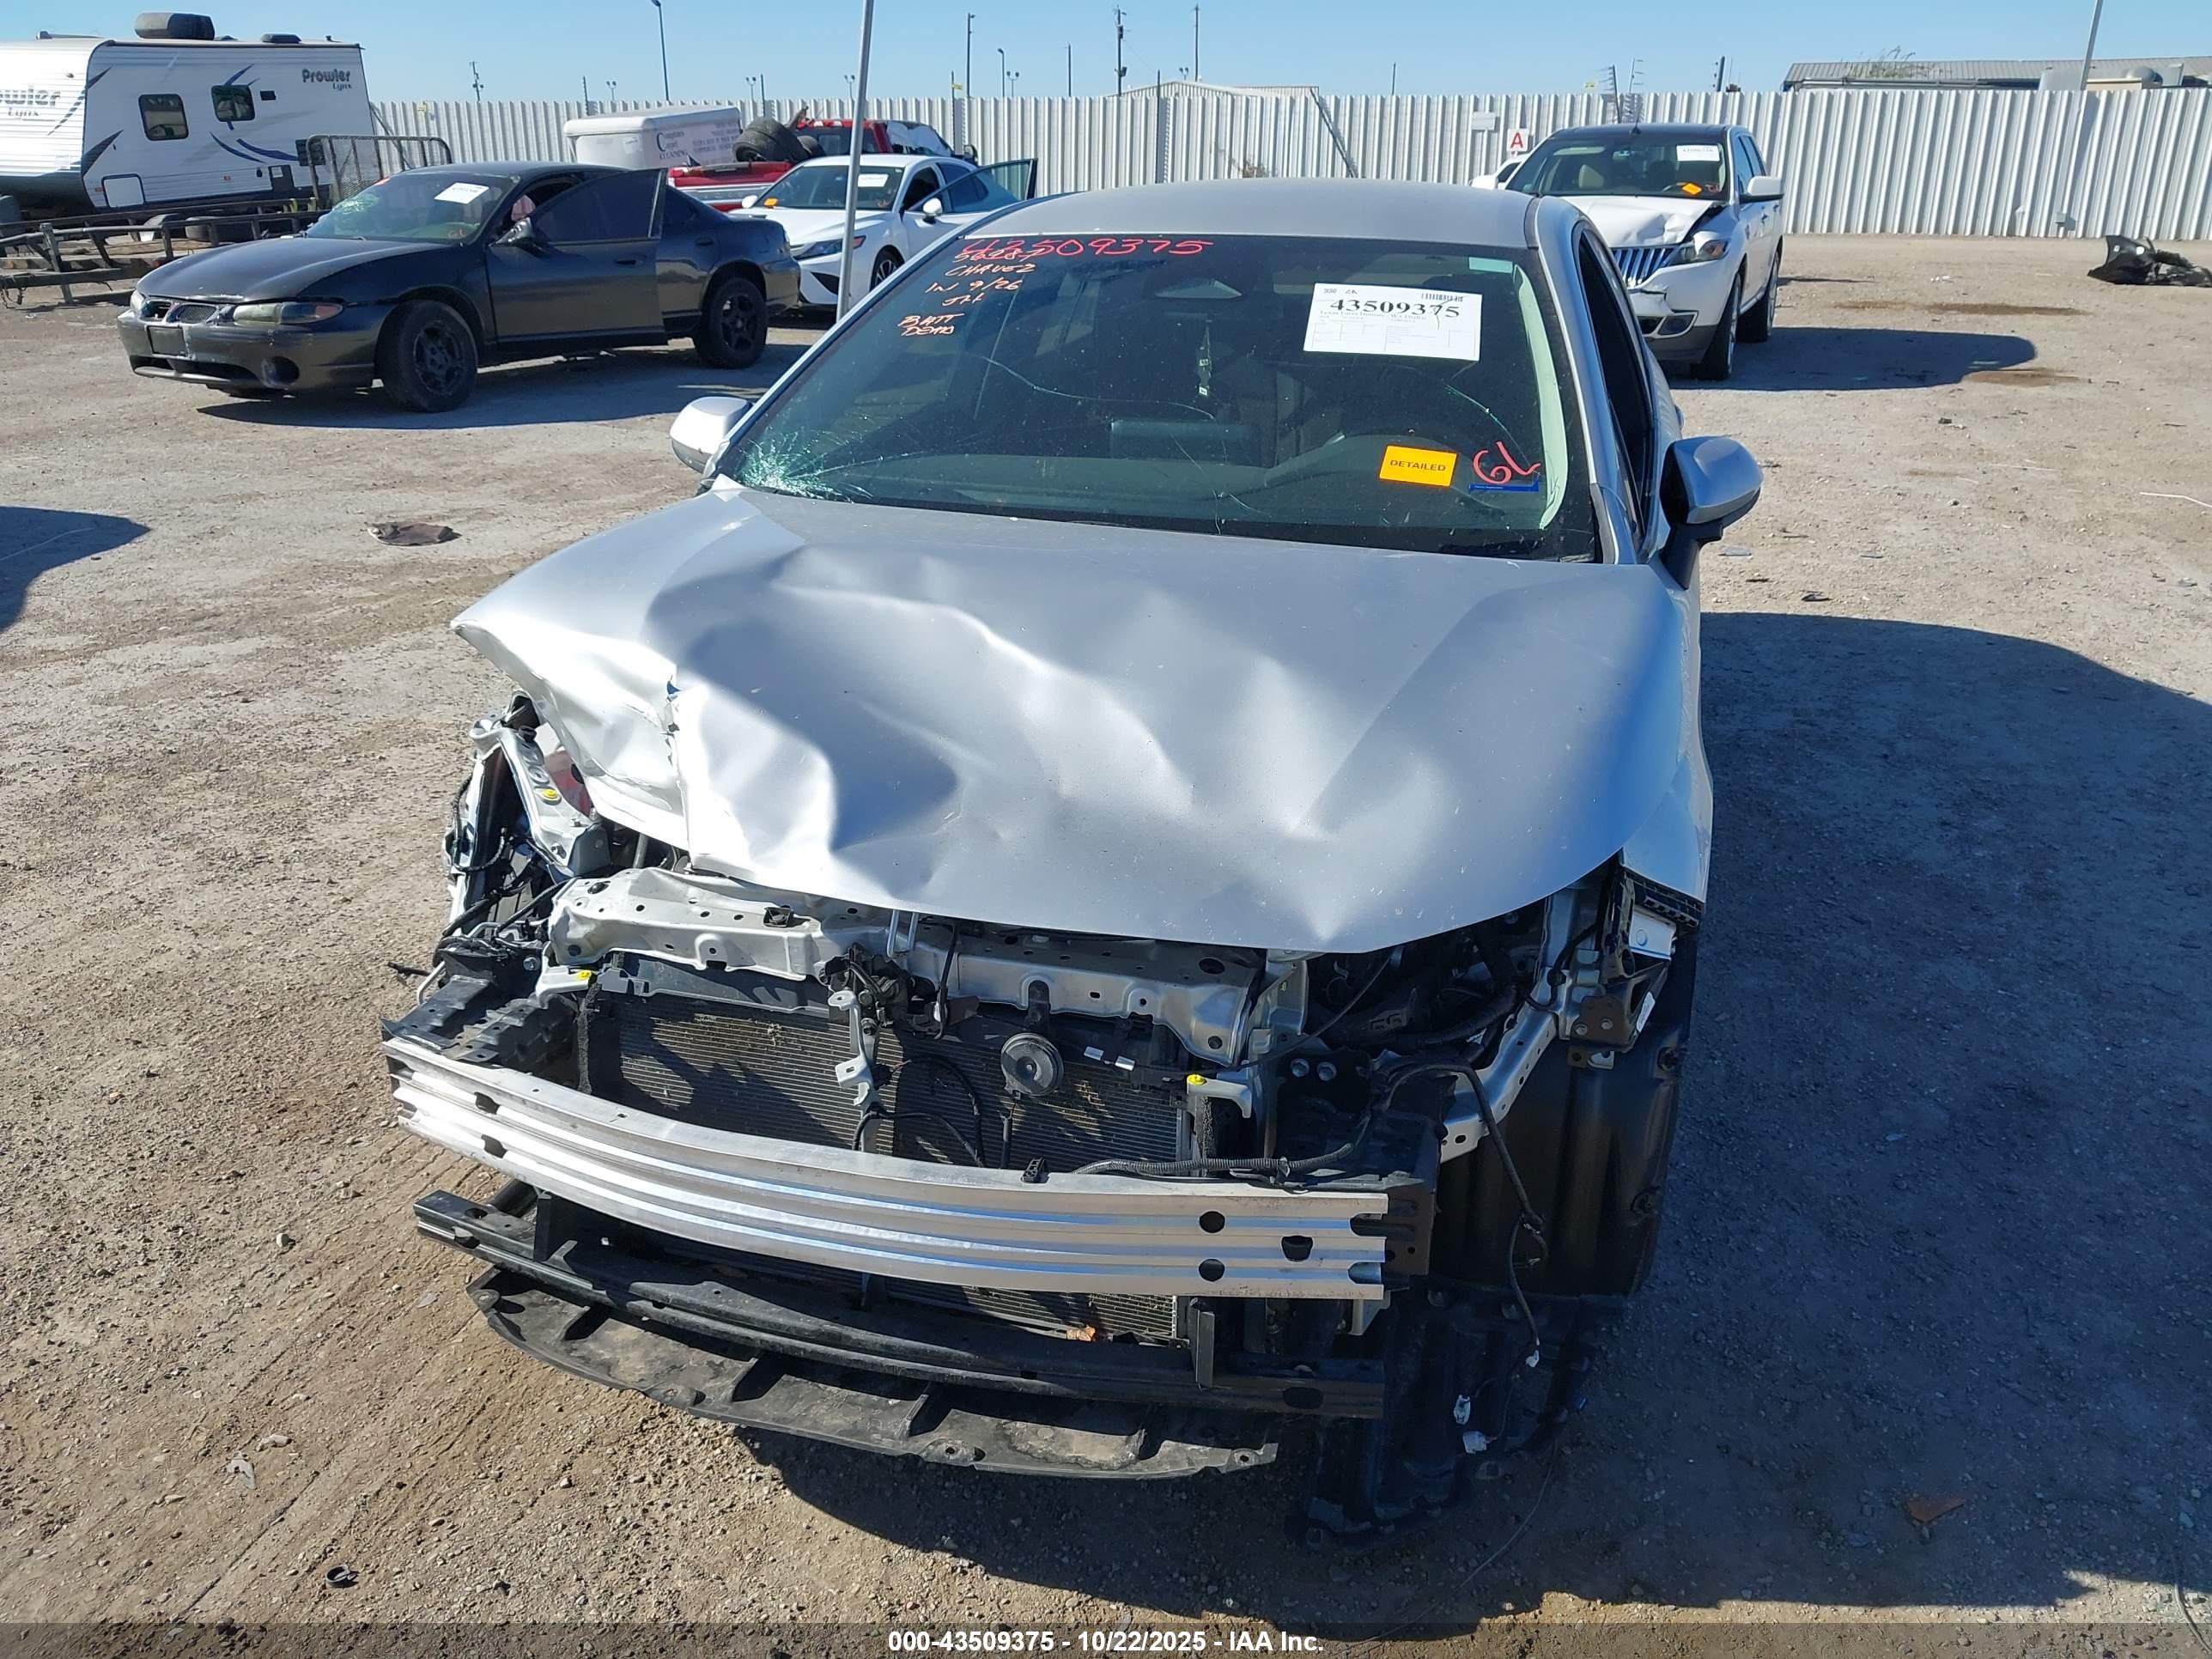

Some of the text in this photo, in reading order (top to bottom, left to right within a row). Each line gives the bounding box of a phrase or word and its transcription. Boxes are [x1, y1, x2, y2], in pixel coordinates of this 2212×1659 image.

[302, 69, 350, 82] Prowler
[0, 85, 60, 106] wler
[1510, 131, 1524, 149] A
[969, 276, 1023, 291] 9/26
[1330, 299, 1461, 318] 43509375
[897, 313, 965, 328] BATT
[1389, 459, 1446, 471] DETAILED
